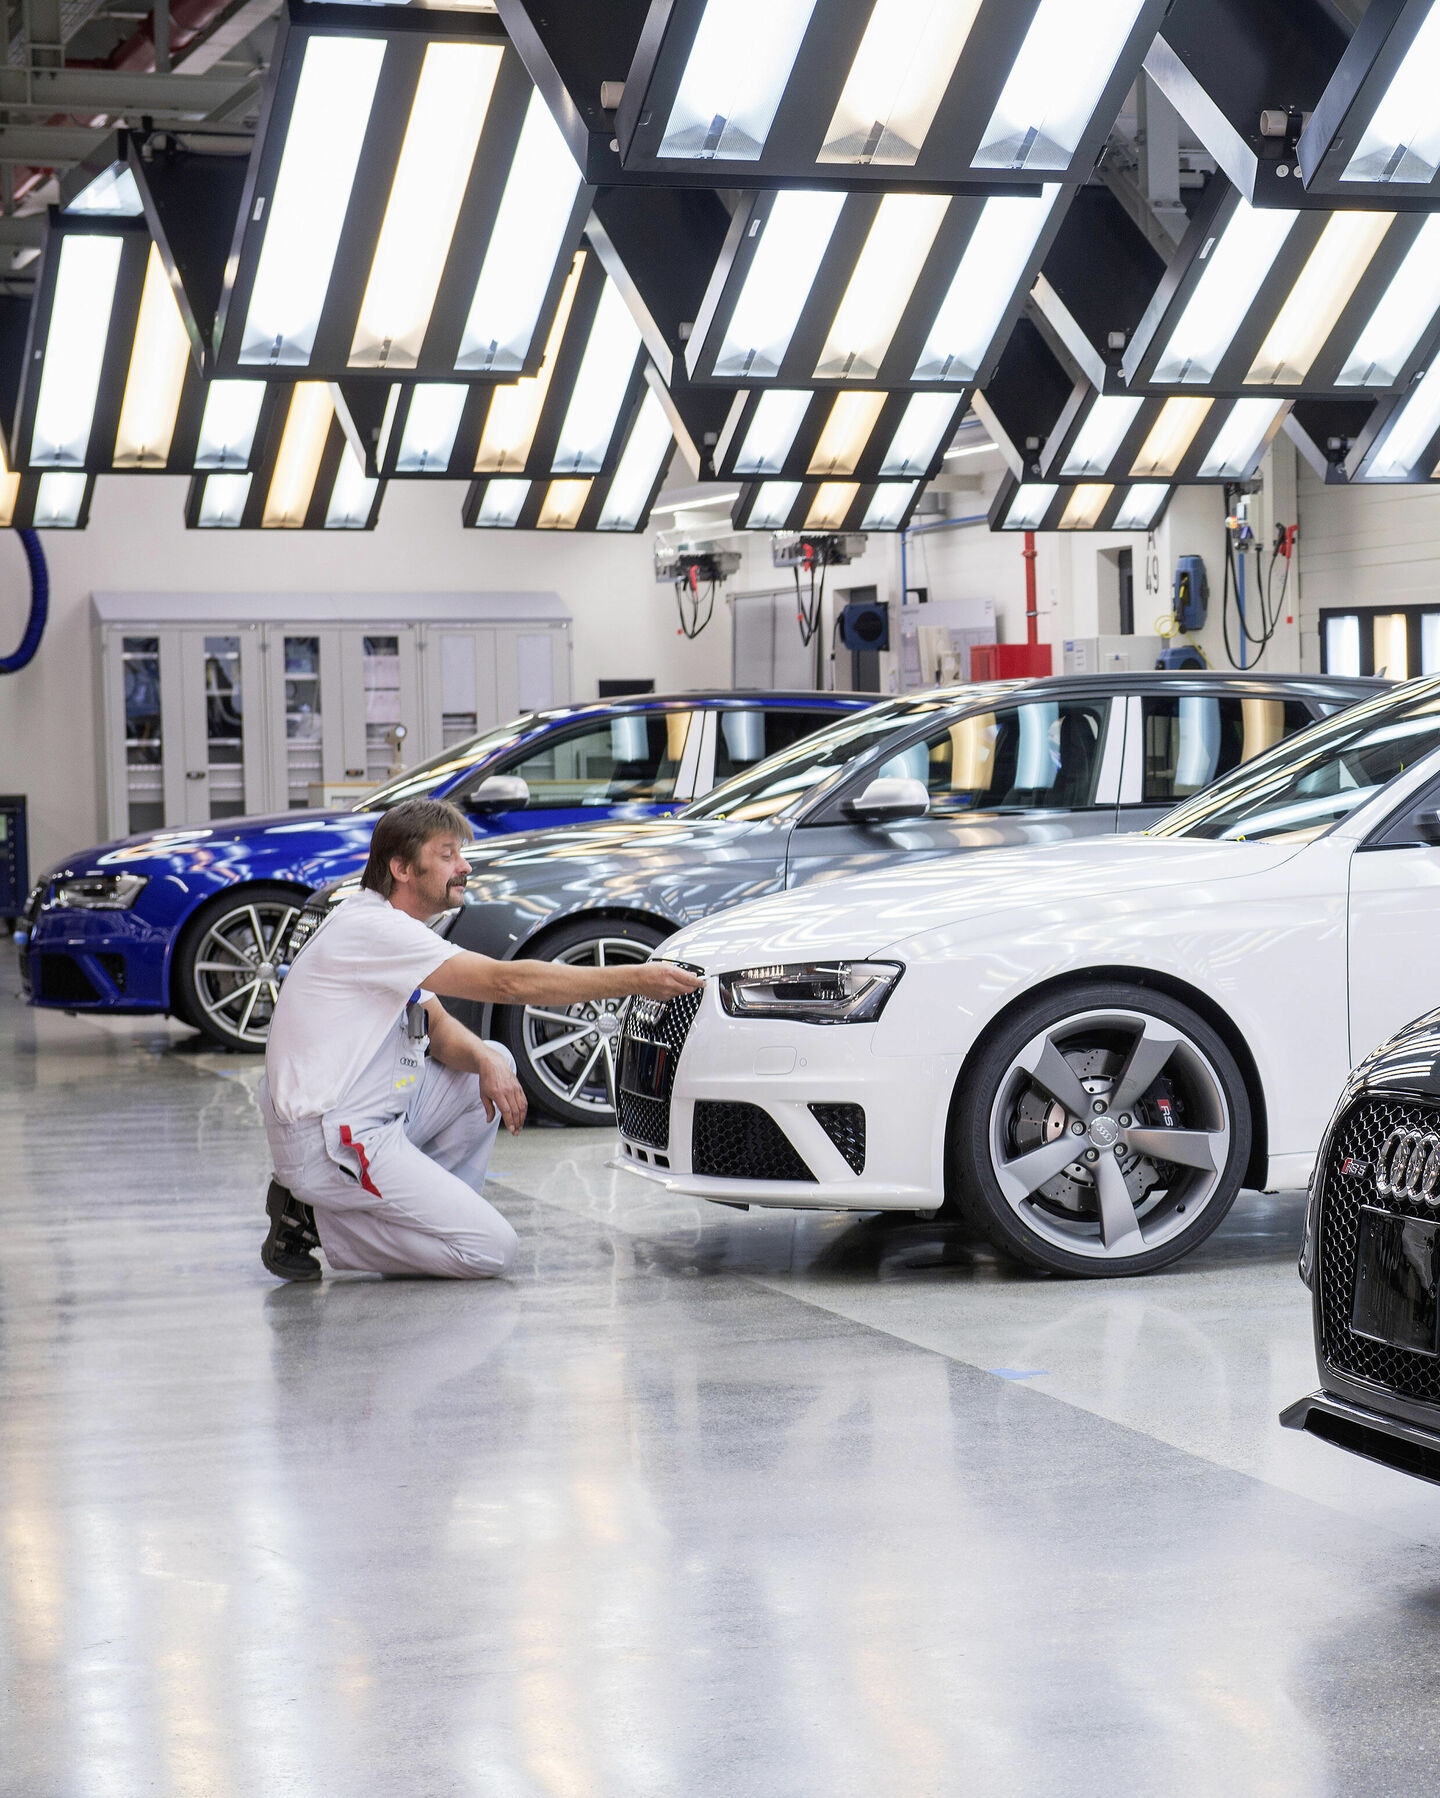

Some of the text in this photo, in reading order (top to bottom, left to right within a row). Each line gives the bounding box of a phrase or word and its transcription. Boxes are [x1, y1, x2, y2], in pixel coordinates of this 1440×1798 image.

[1146, 555, 1159, 595] 49
[1160, 1105, 1174, 1127] RS
[1344, 1160, 1367, 1176] RS5
